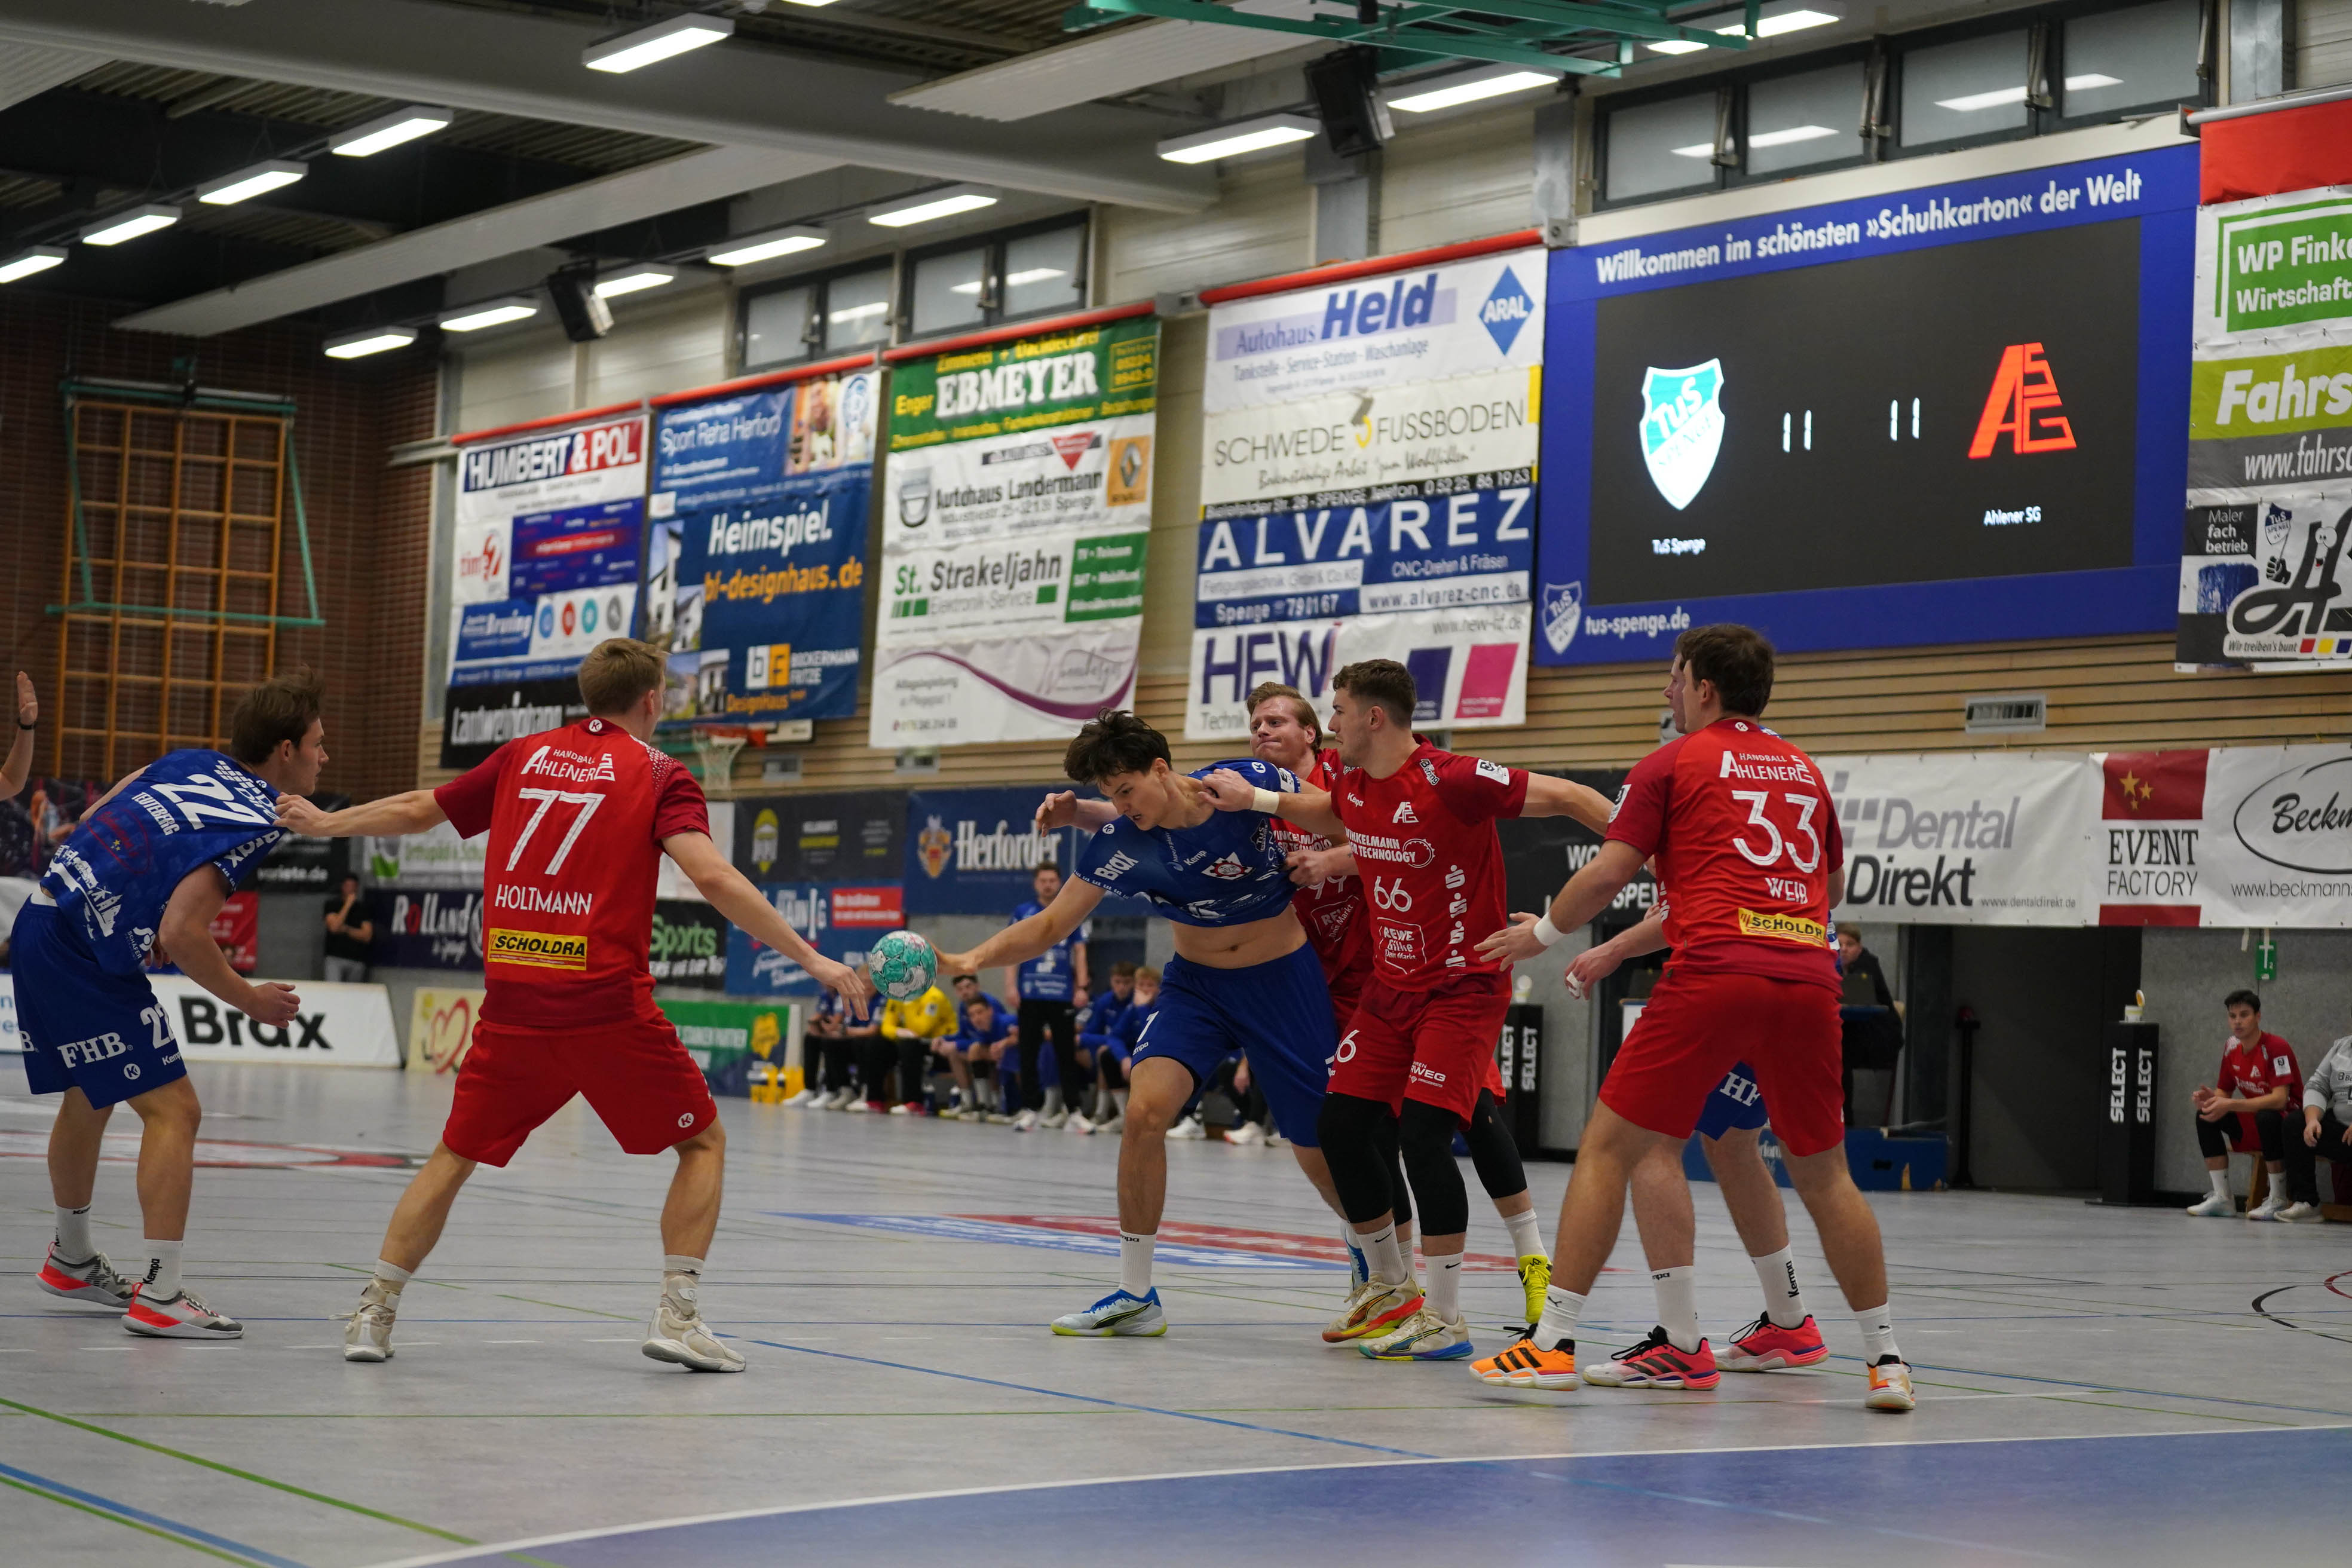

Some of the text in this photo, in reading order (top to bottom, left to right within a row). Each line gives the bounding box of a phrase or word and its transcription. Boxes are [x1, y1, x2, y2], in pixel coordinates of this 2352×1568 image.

[1597, 244, 1719, 284] Willkommen
[1726, 234, 1751, 262] im
[1757, 221, 1859, 257] schönsten
[2039, 180, 2080, 213] der
[2087, 169, 2142, 206] Welt
[2238, 240, 2283, 274] WP
[1235, 273, 1438, 354] Autohaus Held
[1484, 298, 1528, 323] ARAL
[936, 351, 1098, 418] EBMEYER
[895, 394, 933, 416] Enger
[1650, 376, 1702, 439] TuS
[660, 427, 696, 458] Sport
[698, 421, 730, 447] Reha
[1214, 399, 1523, 467] SCHWEDE FUSSBODEN
[467, 436, 571, 490] HUMBERT
[571, 432, 588, 472] &
[590, 425, 637, 470] POL
[937, 485, 1002, 509] Autohaus
[1316, 488, 1367, 507] SPENGE
[1203, 488, 1530, 569] ALVAREZ
[1983, 506, 2041, 526] Ahlener SG
[2207, 525, 2237, 538] fach
[2209, 510, 2243, 523] Maler
[1652, 538, 1706, 555] TuS Spenge
[2206, 539, 2248, 554] betrieb
[895, 549, 1061, 595] St. Strakeljahn
[1460, 555, 1468, 571] &
[704, 555, 863, 604] bf-designhaus.de
[1215, 603, 1270, 625] Spenge
[1549, 590, 1573, 617] TuS
[1585, 605, 1690, 639] tus-spenge.de
[2228, 640, 2298, 652] Wir treiben's bunt
[1202, 629, 1336, 705] HEW
[553, 749, 596, 765] HANDBALL
[1720, 751, 1797, 781] AHLENER
[1740, 753, 1787, 763] HANDBALL
[131, 792, 180, 835] TEUTEBERG
[1877, 796, 2021, 850] Dental
[506, 788, 606, 875] 77
[954, 819, 1062, 870] Herforder
[1731, 790, 1821, 874] 33
[2109, 829, 2198, 865] EVENT
[1094, 850, 1139, 881] Brax
[1358, 845, 1416, 863] TECHNOLOGY
[1374, 875, 1413, 912] 66
[1846, 855, 1976, 906] Direkt
[2108, 870, 2198, 897] FACTORY
[2231, 880, 2352, 898] www.beckmann
[495, 884, 592, 915] HOLTMANN
[1338, 904, 1353, 926] Markt
[1980, 896, 2077, 909] www.dentaldirekt.de
[127, 930, 142, 959] SCHÄFER
[1383, 926, 1415, 942] REWE
[1751, 917, 1826, 941] SCHOLDR
[495, 935, 585, 957] SCHOLDRA
[179, 996, 332, 1049] Brax
[57, 1032, 127, 1068] FHB
[1501, 1024, 1514, 1089] SELECT
[1521, 1026, 1538, 1091] SELECT
[2110, 1047, 2126, 1123] SELECT
[2137, 1048, 2152, 1124] SELECT
[142, 1258, 160, 1285] Kempa
[1786, 1260, 1799, 1298] Kempa
